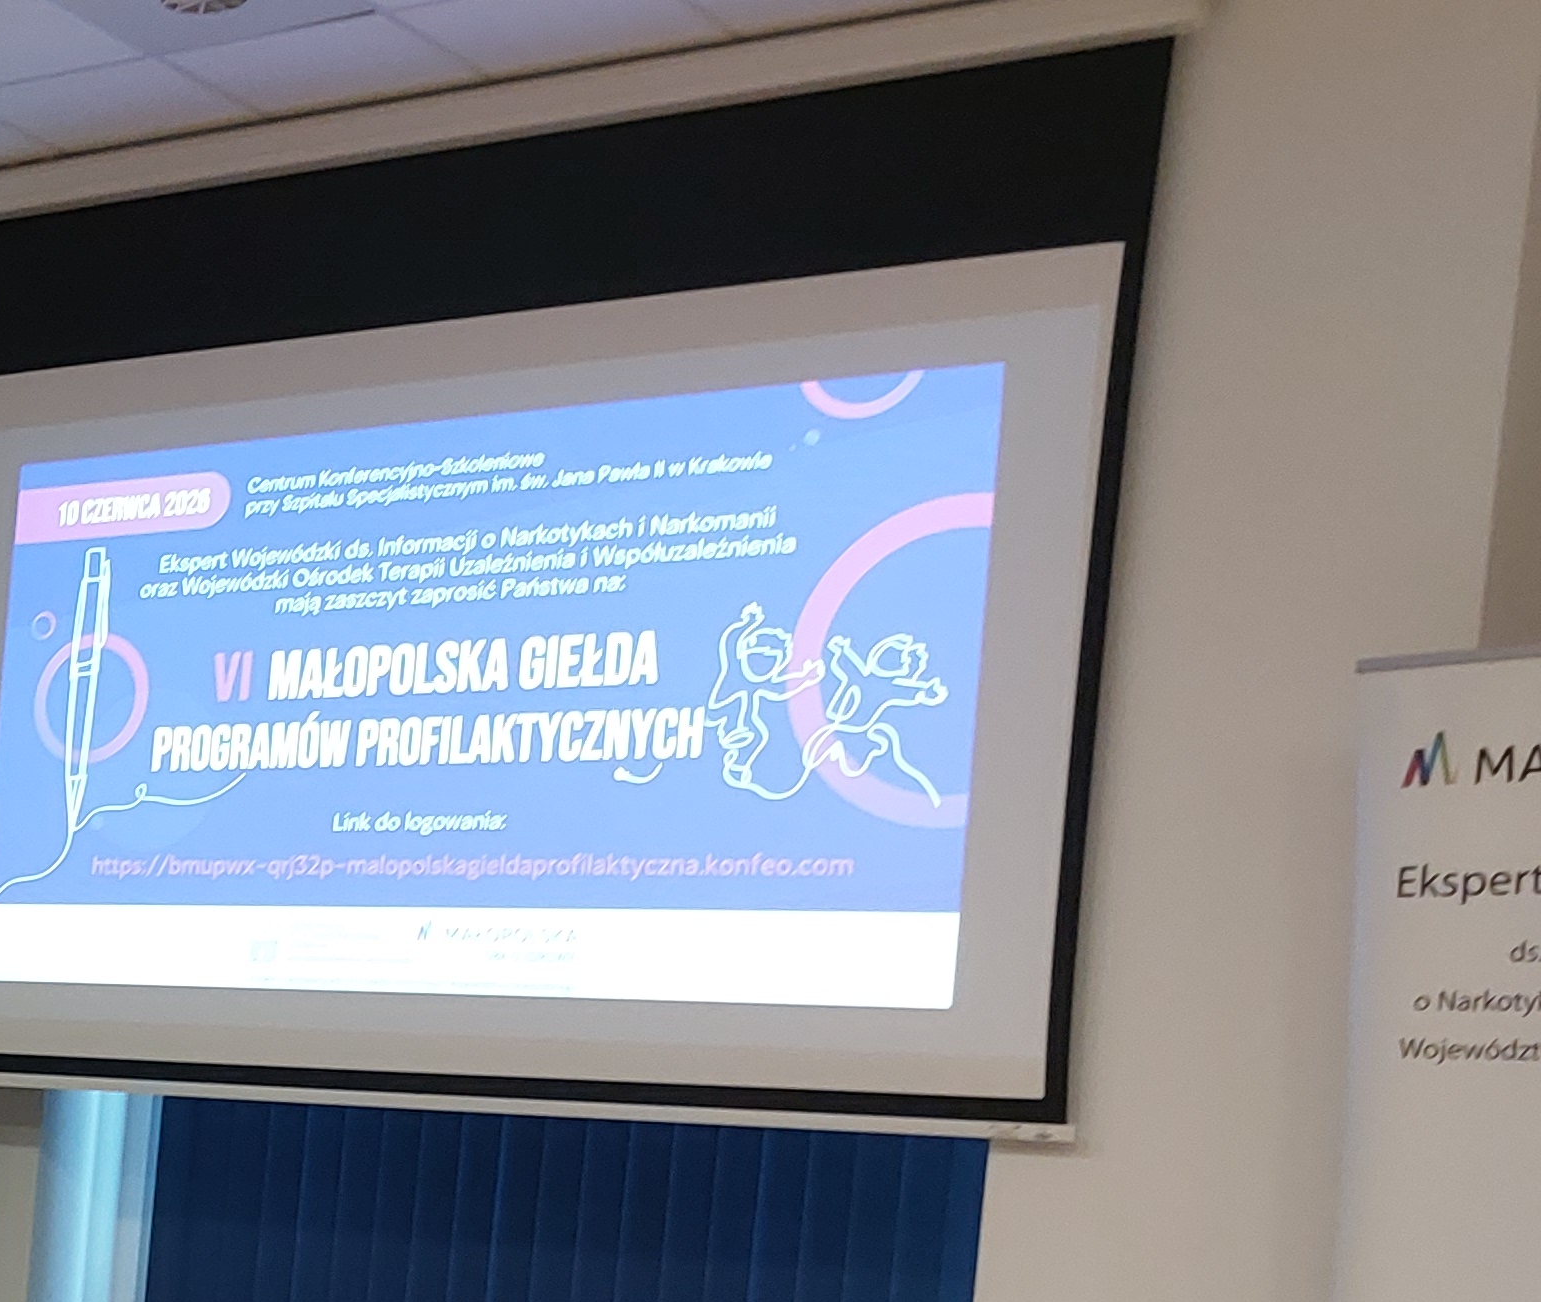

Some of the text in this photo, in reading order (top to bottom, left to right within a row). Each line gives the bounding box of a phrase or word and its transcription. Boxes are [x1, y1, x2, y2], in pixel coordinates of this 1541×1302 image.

[244, 498, 281, 519] przy
[282, 491, 345, 515] Szpitalu
[346, 478, 488, 507] Specjalistycznym
[491, 474, 518, 494] im.
[551, 469, 595, 489] Jana
[597, 462, 651, 485] Pawła
[653, 459, 666, 478] II
[668, 462, 686, 478] w
[687, 450, 773, 477] Krakowie
[246, 474, 316, 495] Centrum
[59, 500, 80, 527] 10
[80, 492, 162, 525] CZERWCA
[158, 505, 777, 576] Ekspert Wojewódzki ds. Informacji o Narkotykach i Narkomanii
[139, 533, 797, 600] oraz Wojewódzki Ośrodek Terapii Uzależnienia i Współuzależnienia
[274, 573, 627, 617] mają zaszczyt zaprosić Państwa na:
[214, 629, 660, 702] VI MAŁOPOLSKA GIEŁDA
[150, 704, 707, 774] PROGRAMÓW PROFILAKTYCZNYCH
[331, 810, 508, 836] Link do logowania:
[1396, 864, 1541, 905] Ekspert
[1413, 993, 1431, 1012] o
